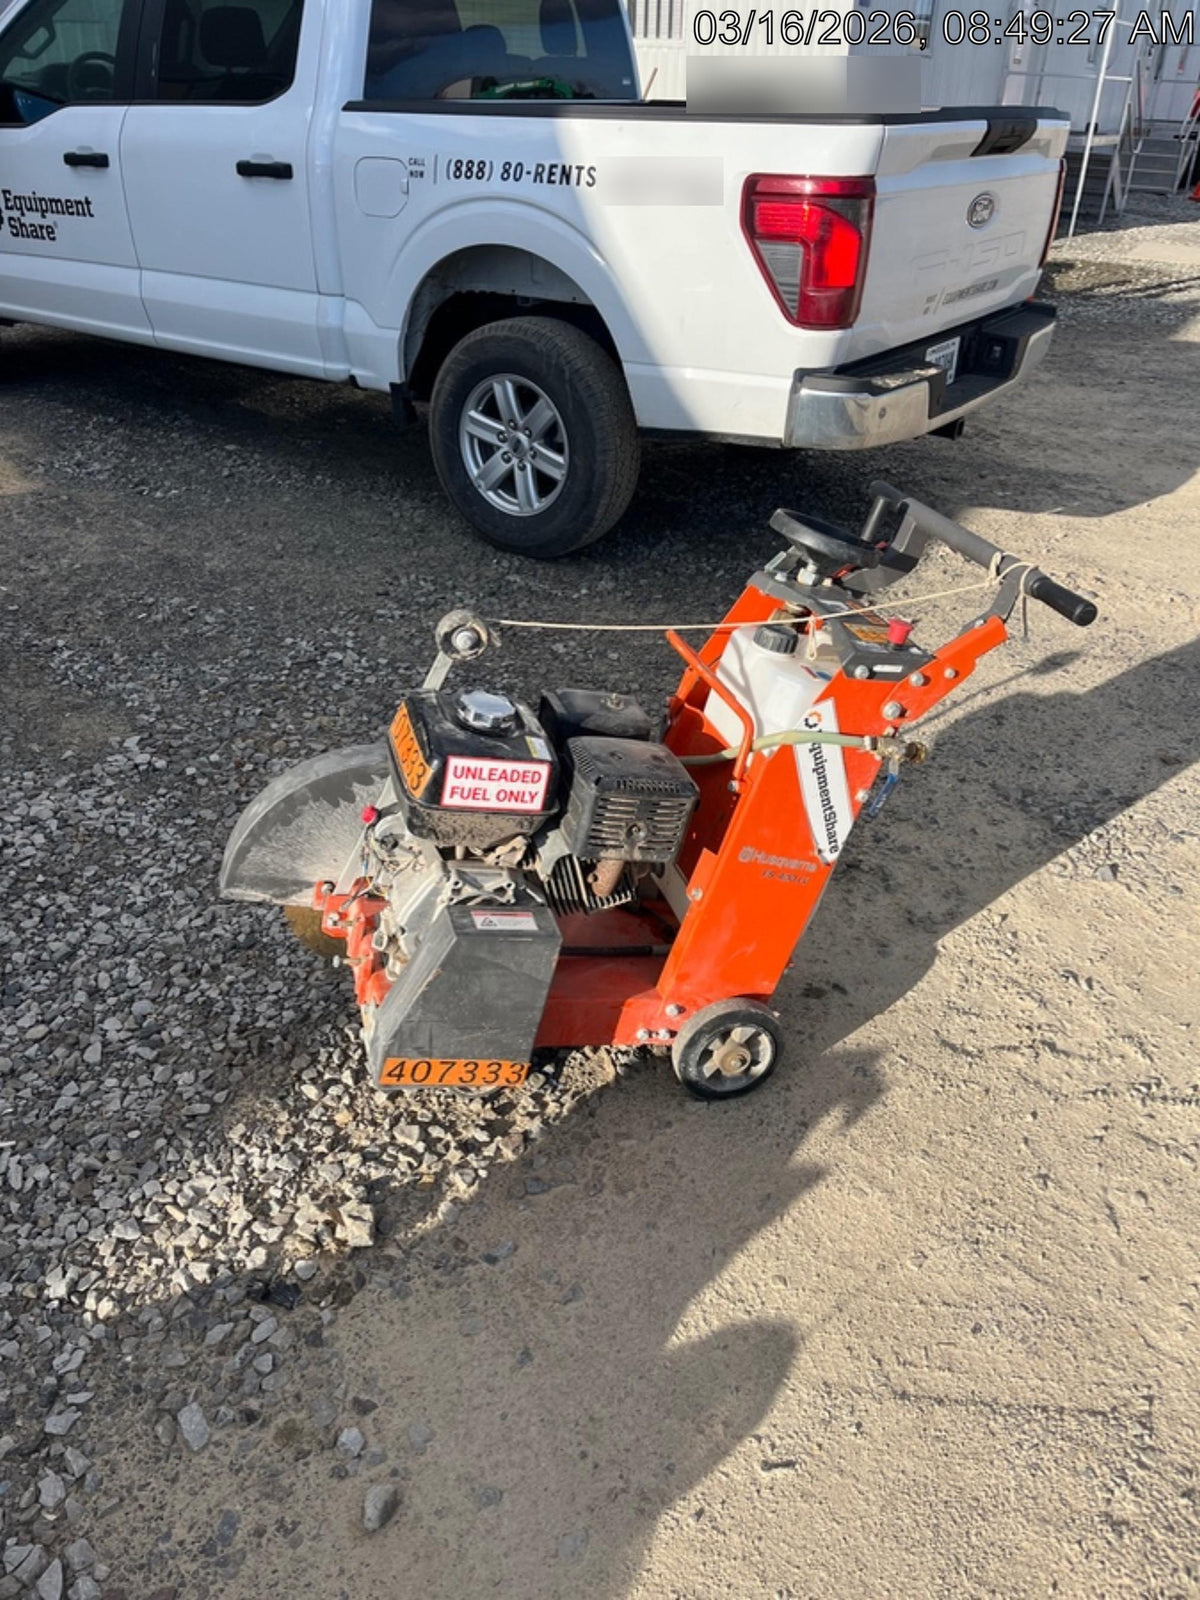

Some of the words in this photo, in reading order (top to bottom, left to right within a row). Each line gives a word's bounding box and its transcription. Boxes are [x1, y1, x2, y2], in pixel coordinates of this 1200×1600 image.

[408, 157, 425, 167] CALL
[409, 169, 424, 179] NOW
[446, 159, 494, 182] (888)
[501, 161, 597, 187] 80-RENTS
[1, 189, 95, 219] Equipment
[8, 216, 57, 241] Share
[452, 765, 542, 784] UNLEADED
[449, 786, 491, 801] FUEL
[495, 788, 540, 804] ONLY
[809, 728, 839, 854] quipmentShare
[386, 1060, 525, 1084] 407333
